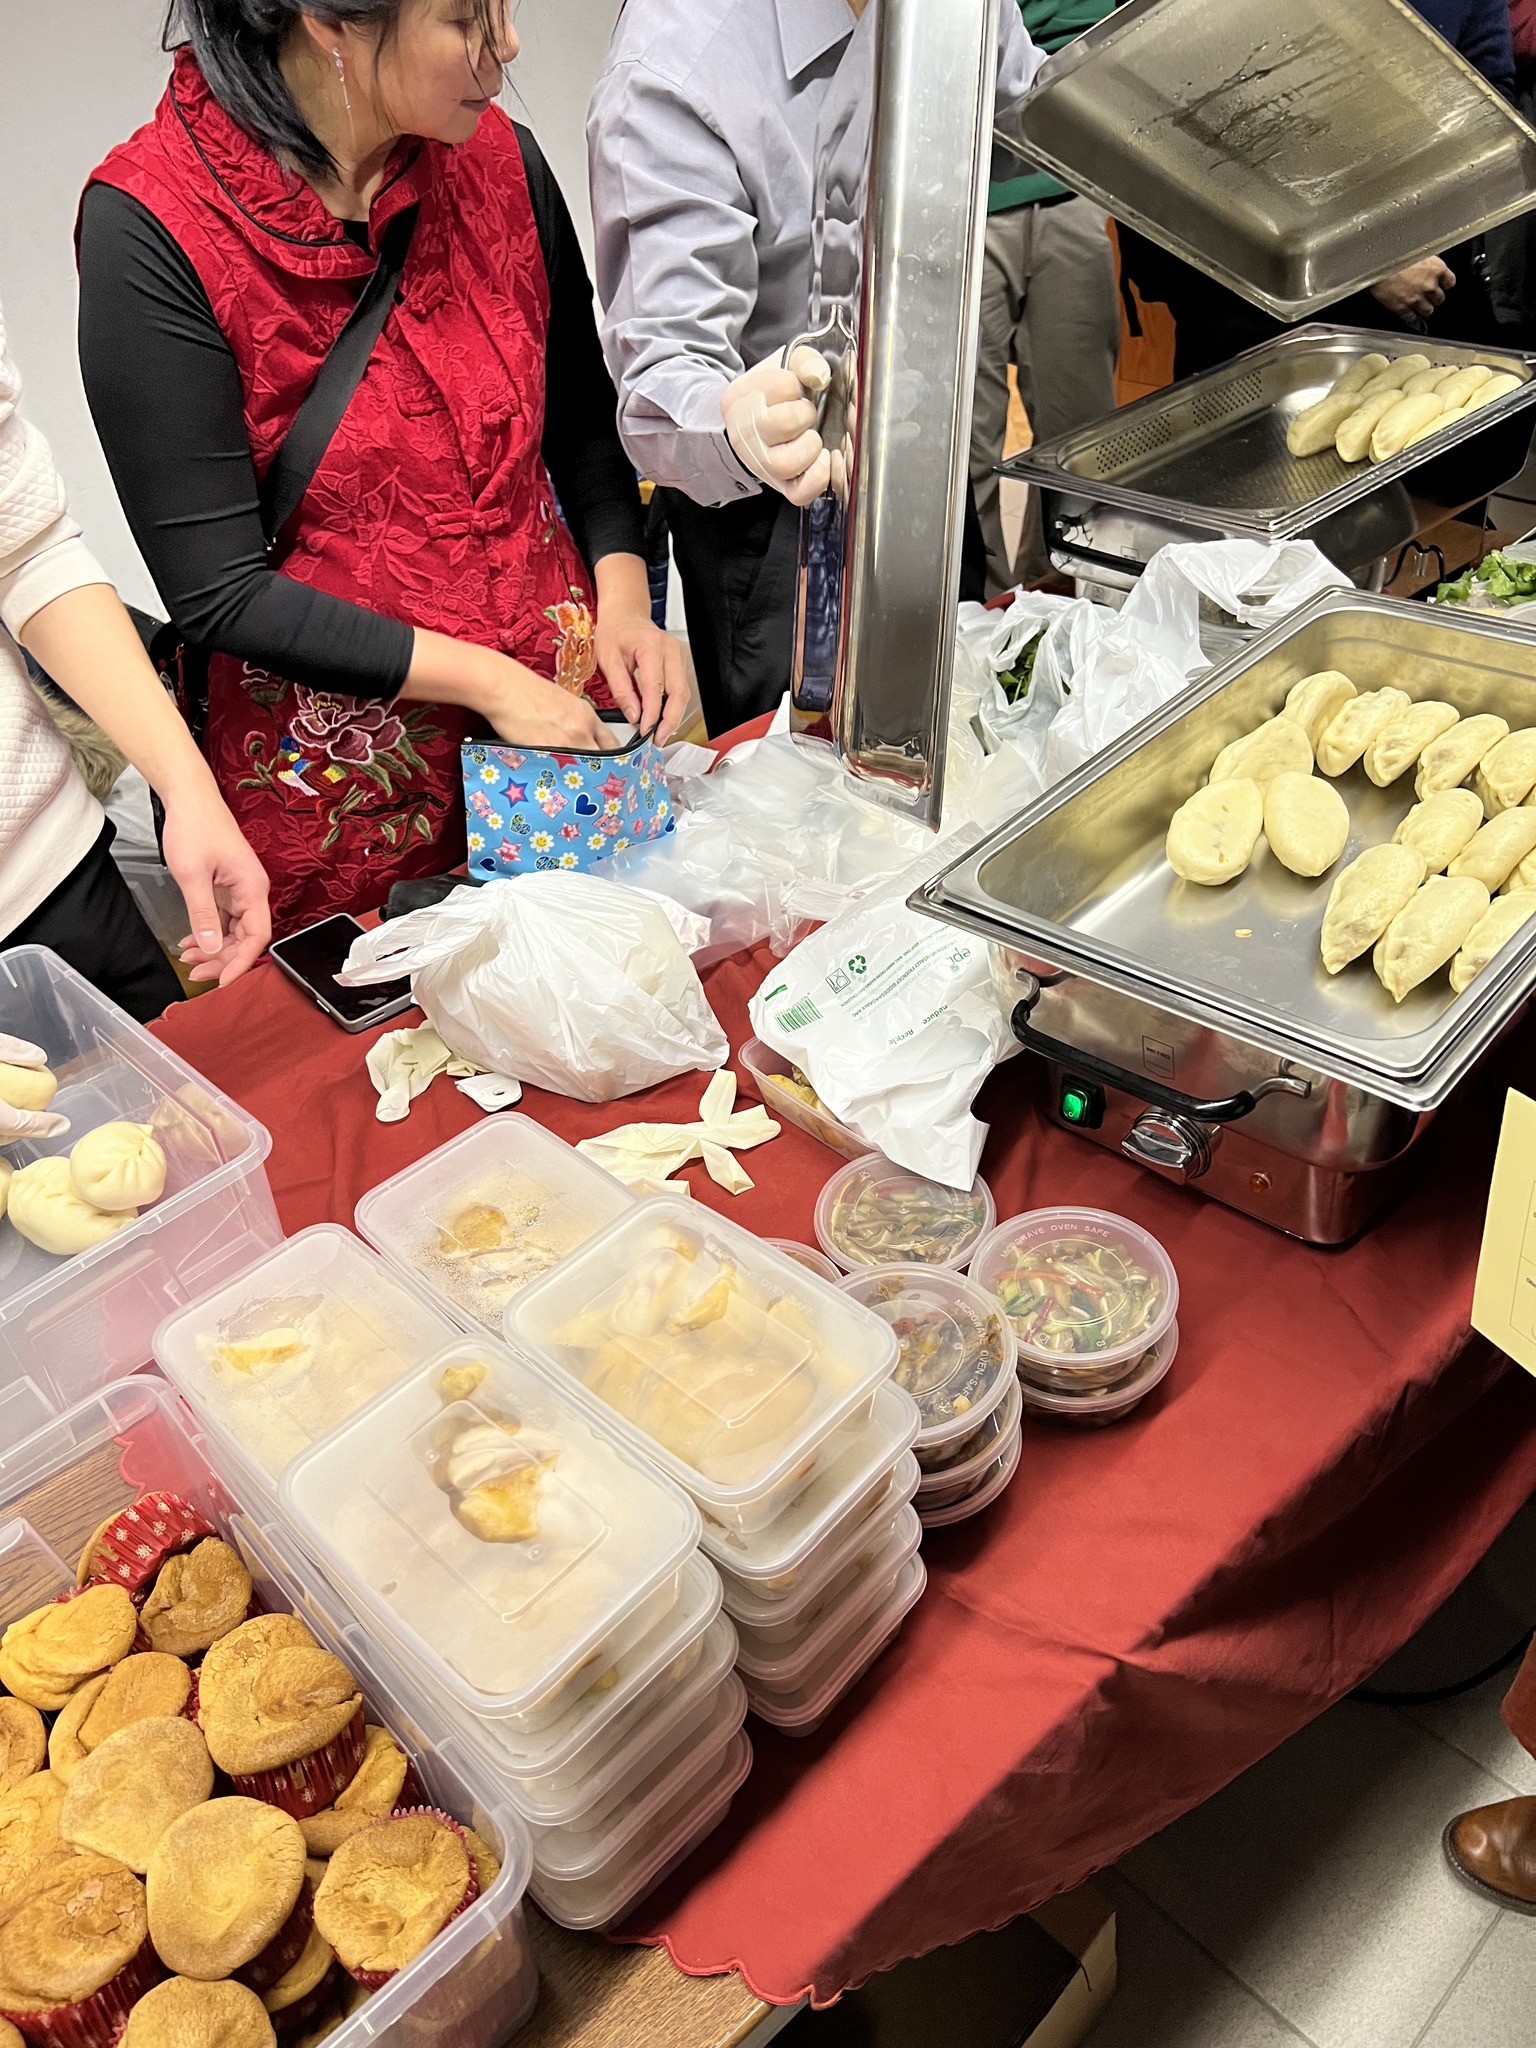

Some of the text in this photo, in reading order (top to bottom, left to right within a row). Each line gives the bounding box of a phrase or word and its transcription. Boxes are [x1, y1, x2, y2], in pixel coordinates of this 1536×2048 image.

[910, 941, 919, 950] KEEP
[875, 969, 886, 979] FROM
[895, 965, 915, 984] FRIENDLY
[1147, 1046, 1171, 1060] METRO
[955, 1224, 971, 1242] OVEN
[1000, 1227, 1046, 1258] MICROWAVE
[1084, 1225, 1111, 1238] SAFE
[954, 1298, 988, 1345] MICROWAVE
[976, 1350, 989, 1377] OVEN
